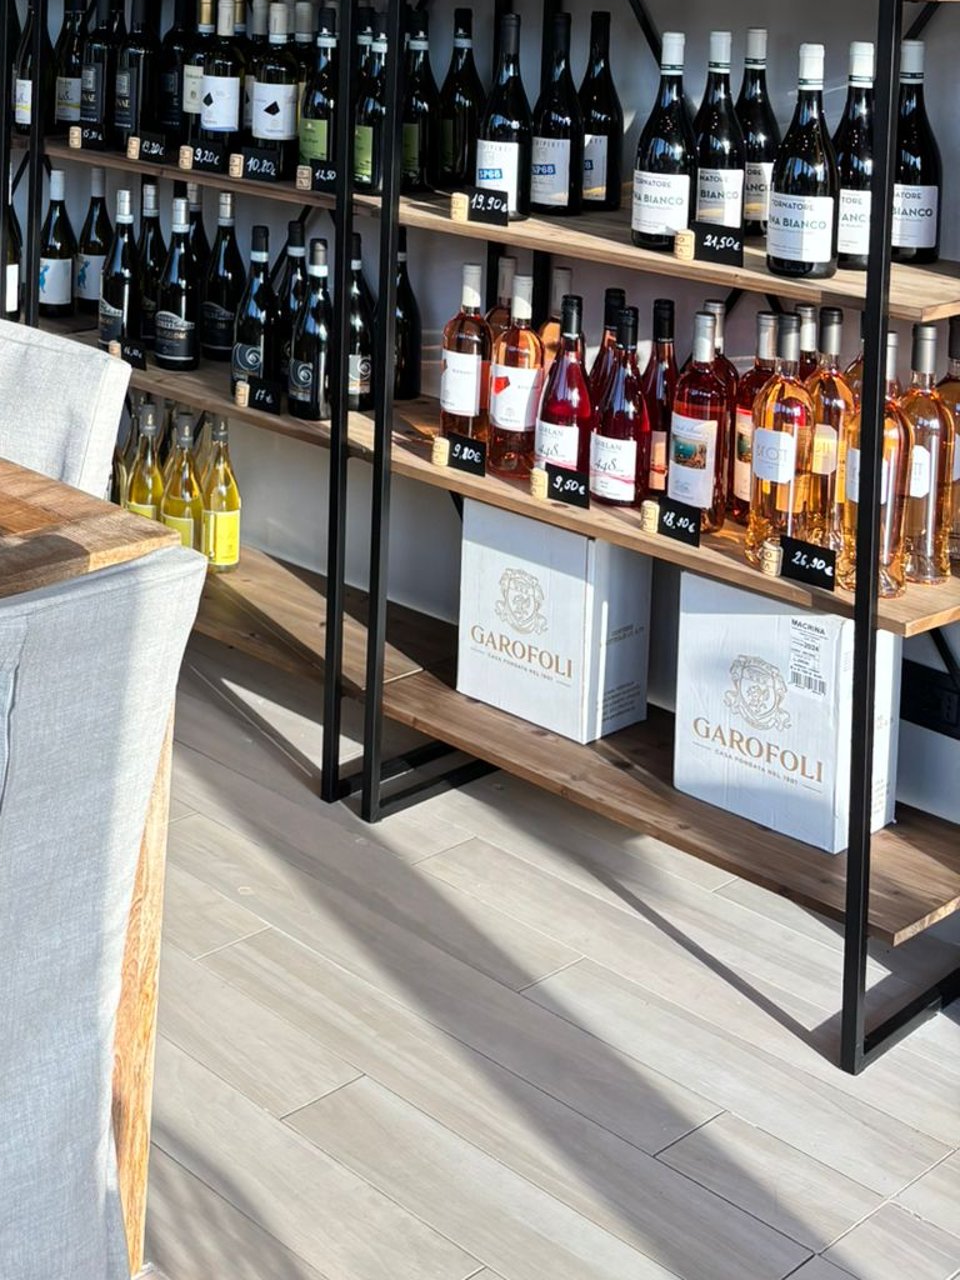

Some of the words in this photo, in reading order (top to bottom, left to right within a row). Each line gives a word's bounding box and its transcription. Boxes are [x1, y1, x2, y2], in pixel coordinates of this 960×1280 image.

[471, 193, 509, 213] 19,90€
[643, 194, 684, 207] BIANCO
[782, 217, 827, 230] BIANCO
[703, 234, 741, 252] 21,50€
[553, 475, 587, 496] 9,50€
[791, 550, 834, 577] 26,90€
[470, 624, 573, 679] GAROFOLI
[692, 716, 823, 784] GAROFOLI
